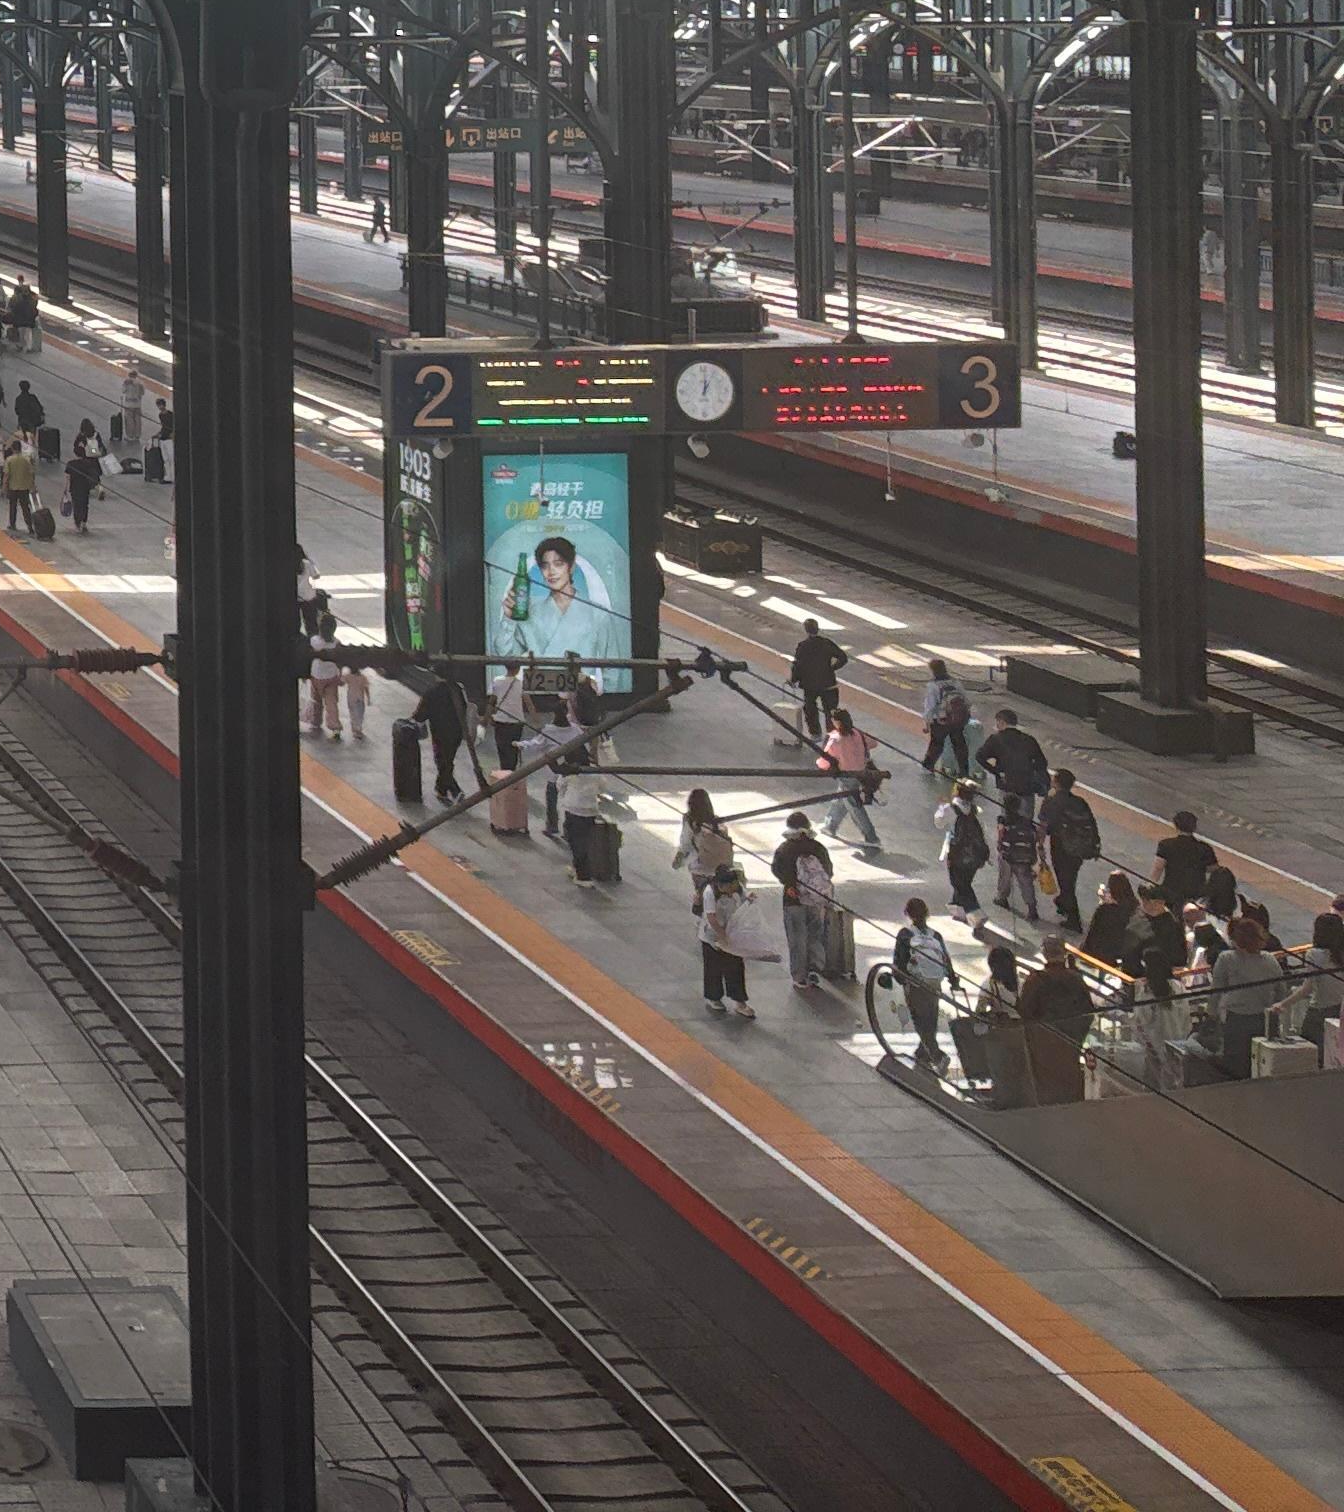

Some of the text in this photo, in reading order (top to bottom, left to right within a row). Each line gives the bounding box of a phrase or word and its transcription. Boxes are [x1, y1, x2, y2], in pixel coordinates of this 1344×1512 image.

[368, 131, 403, 143] 出站口
[486, 127, 521, 140] 出站口
[413, 365, 454, 427] 2
[960, 355, 1000, 419] 3
[399, 442, 432, 480] 1903
[546, 500, 605, 520] 轻负担
[524, 672, 577, 691] Y2-09
